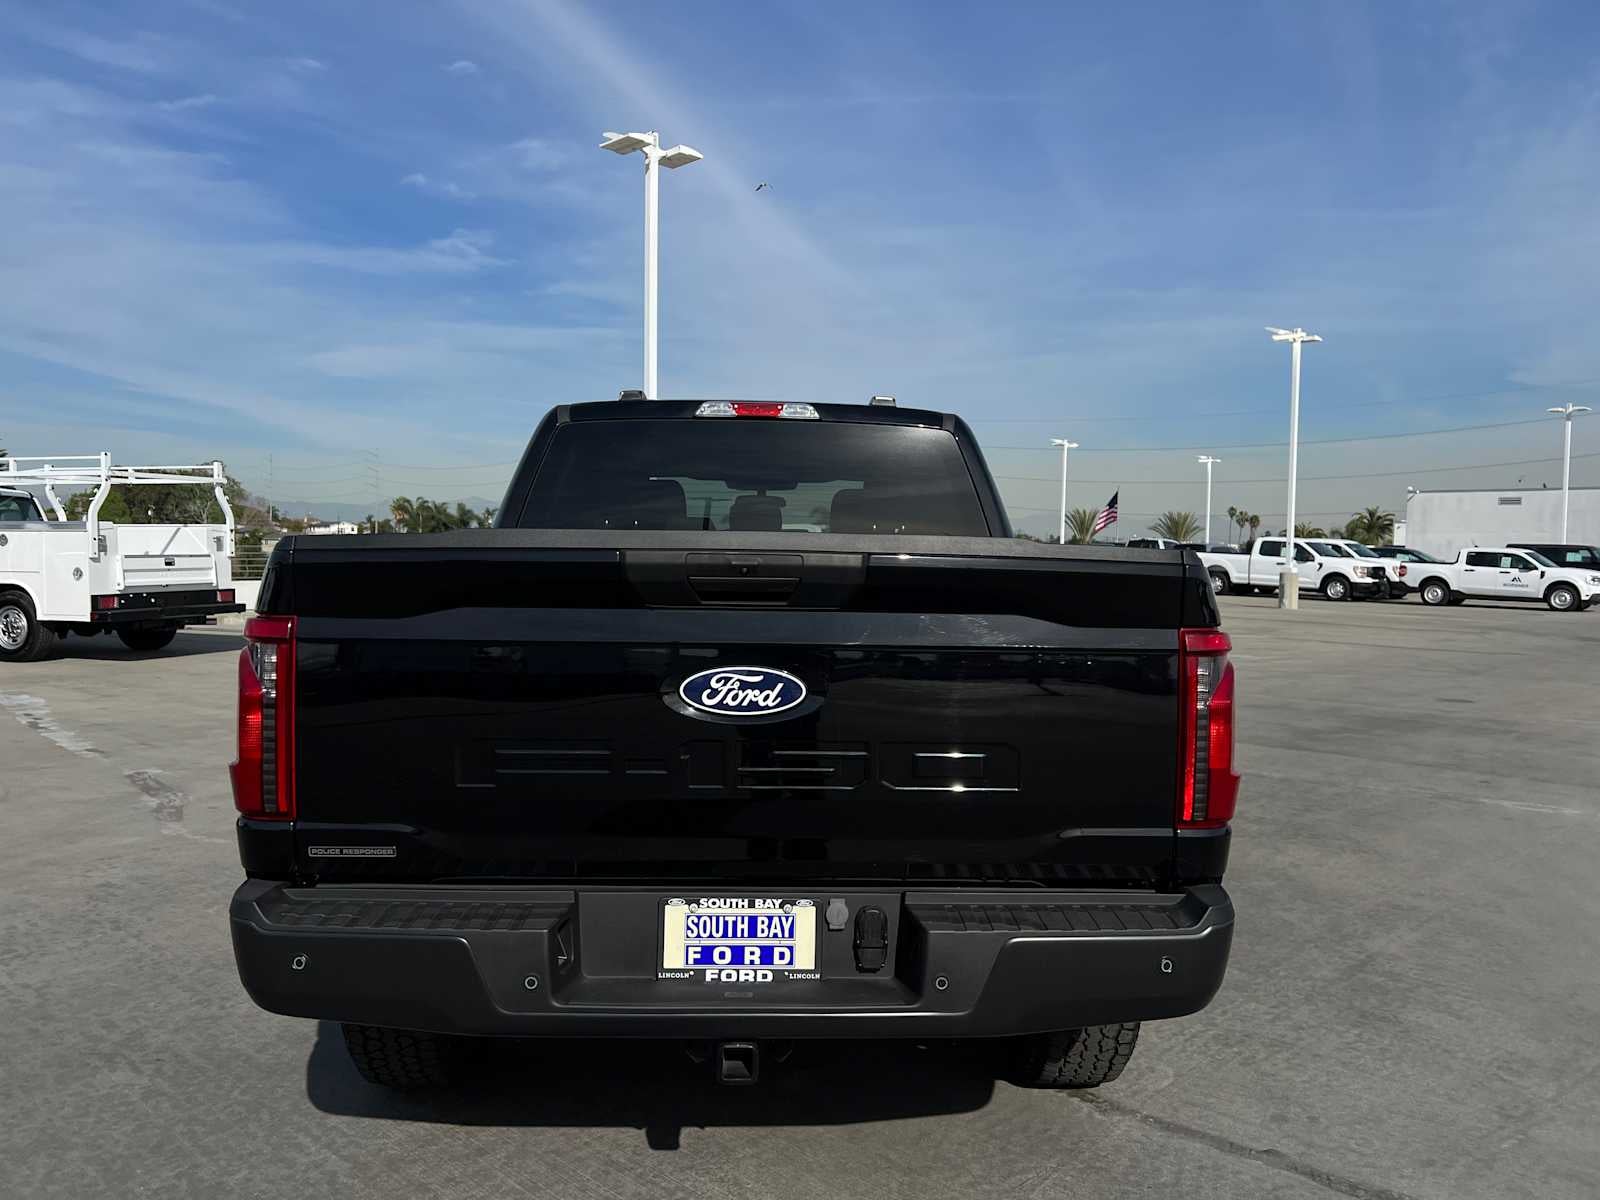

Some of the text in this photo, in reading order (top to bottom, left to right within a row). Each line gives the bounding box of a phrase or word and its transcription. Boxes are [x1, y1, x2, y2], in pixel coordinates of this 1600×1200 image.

[701, 672, 785, 707] Ford
[699, 898, 749, 909] SOUTH
[754, 898, 783, 910] BAY
[686, 915, 793, 938] SOUTH BAY
[687, 946, 791, 965] FORD
[705, 969, 774, 982] FORD
